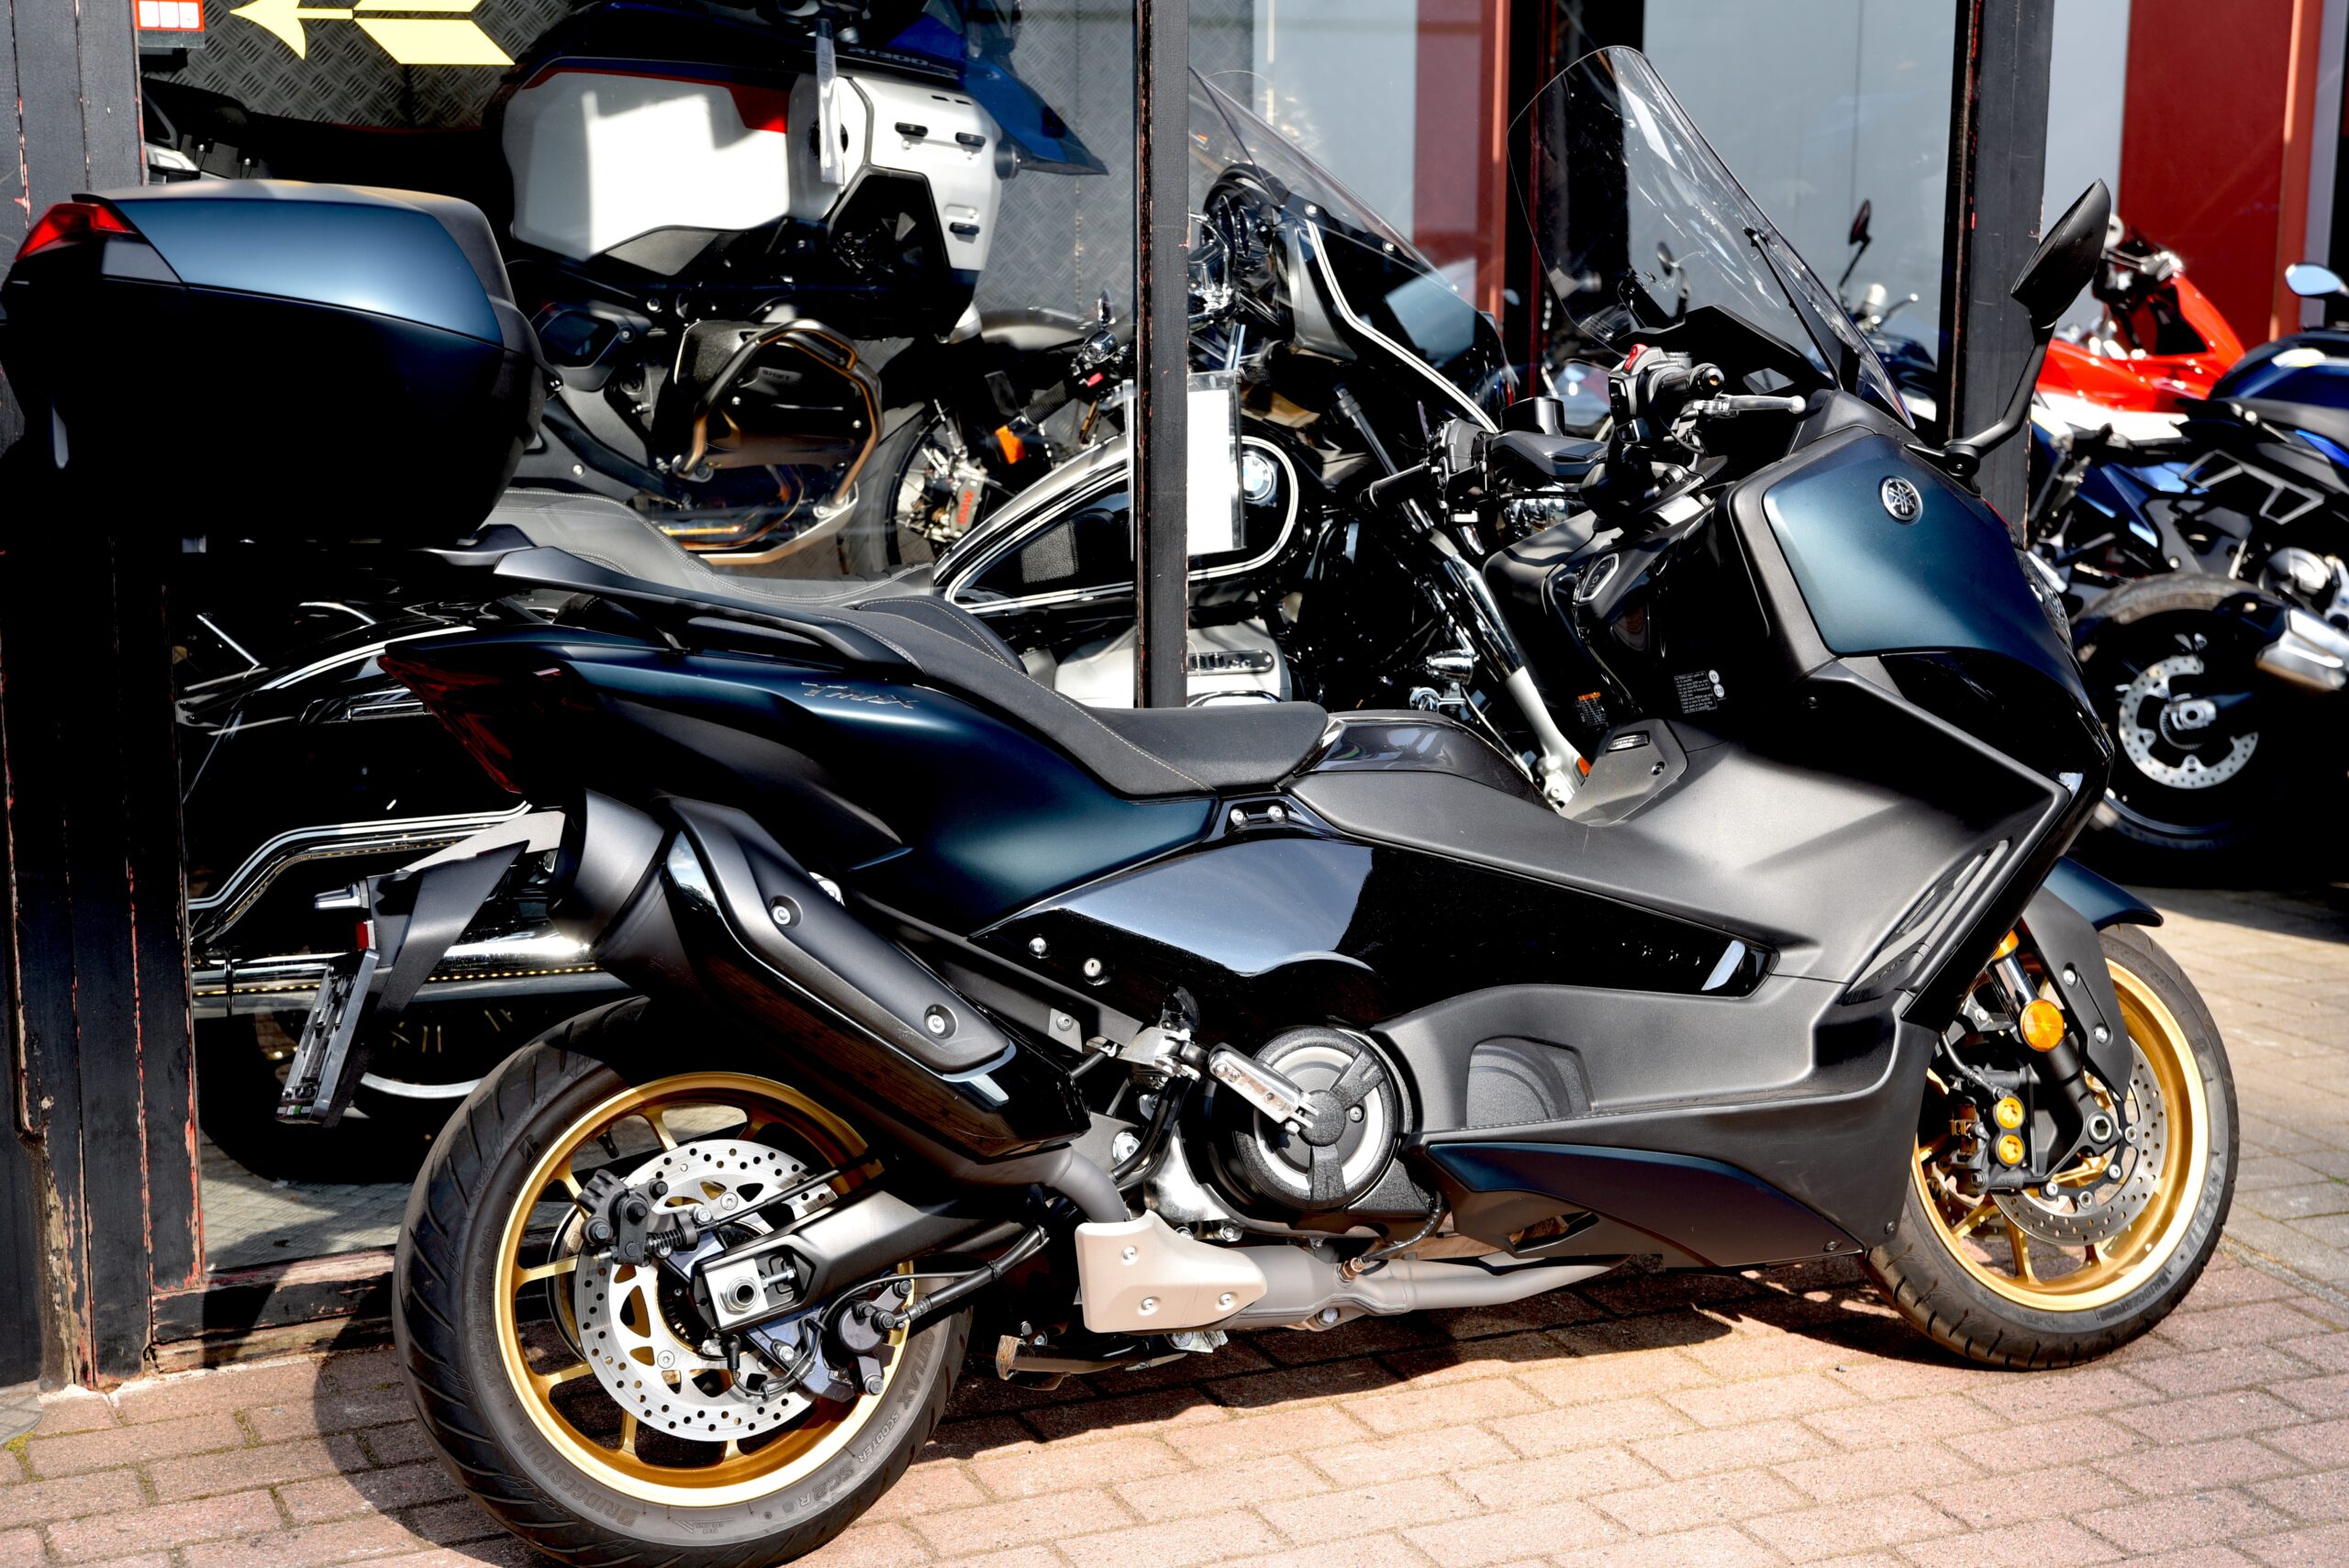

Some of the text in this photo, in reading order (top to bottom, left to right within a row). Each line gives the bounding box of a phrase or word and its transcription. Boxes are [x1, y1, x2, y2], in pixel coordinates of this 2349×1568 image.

[956, 489, 974, 525] BMW
[858, 1409, 900, 1463] SCOOTER
[511, 1430, 641, 1528] BRIDGESTONE
